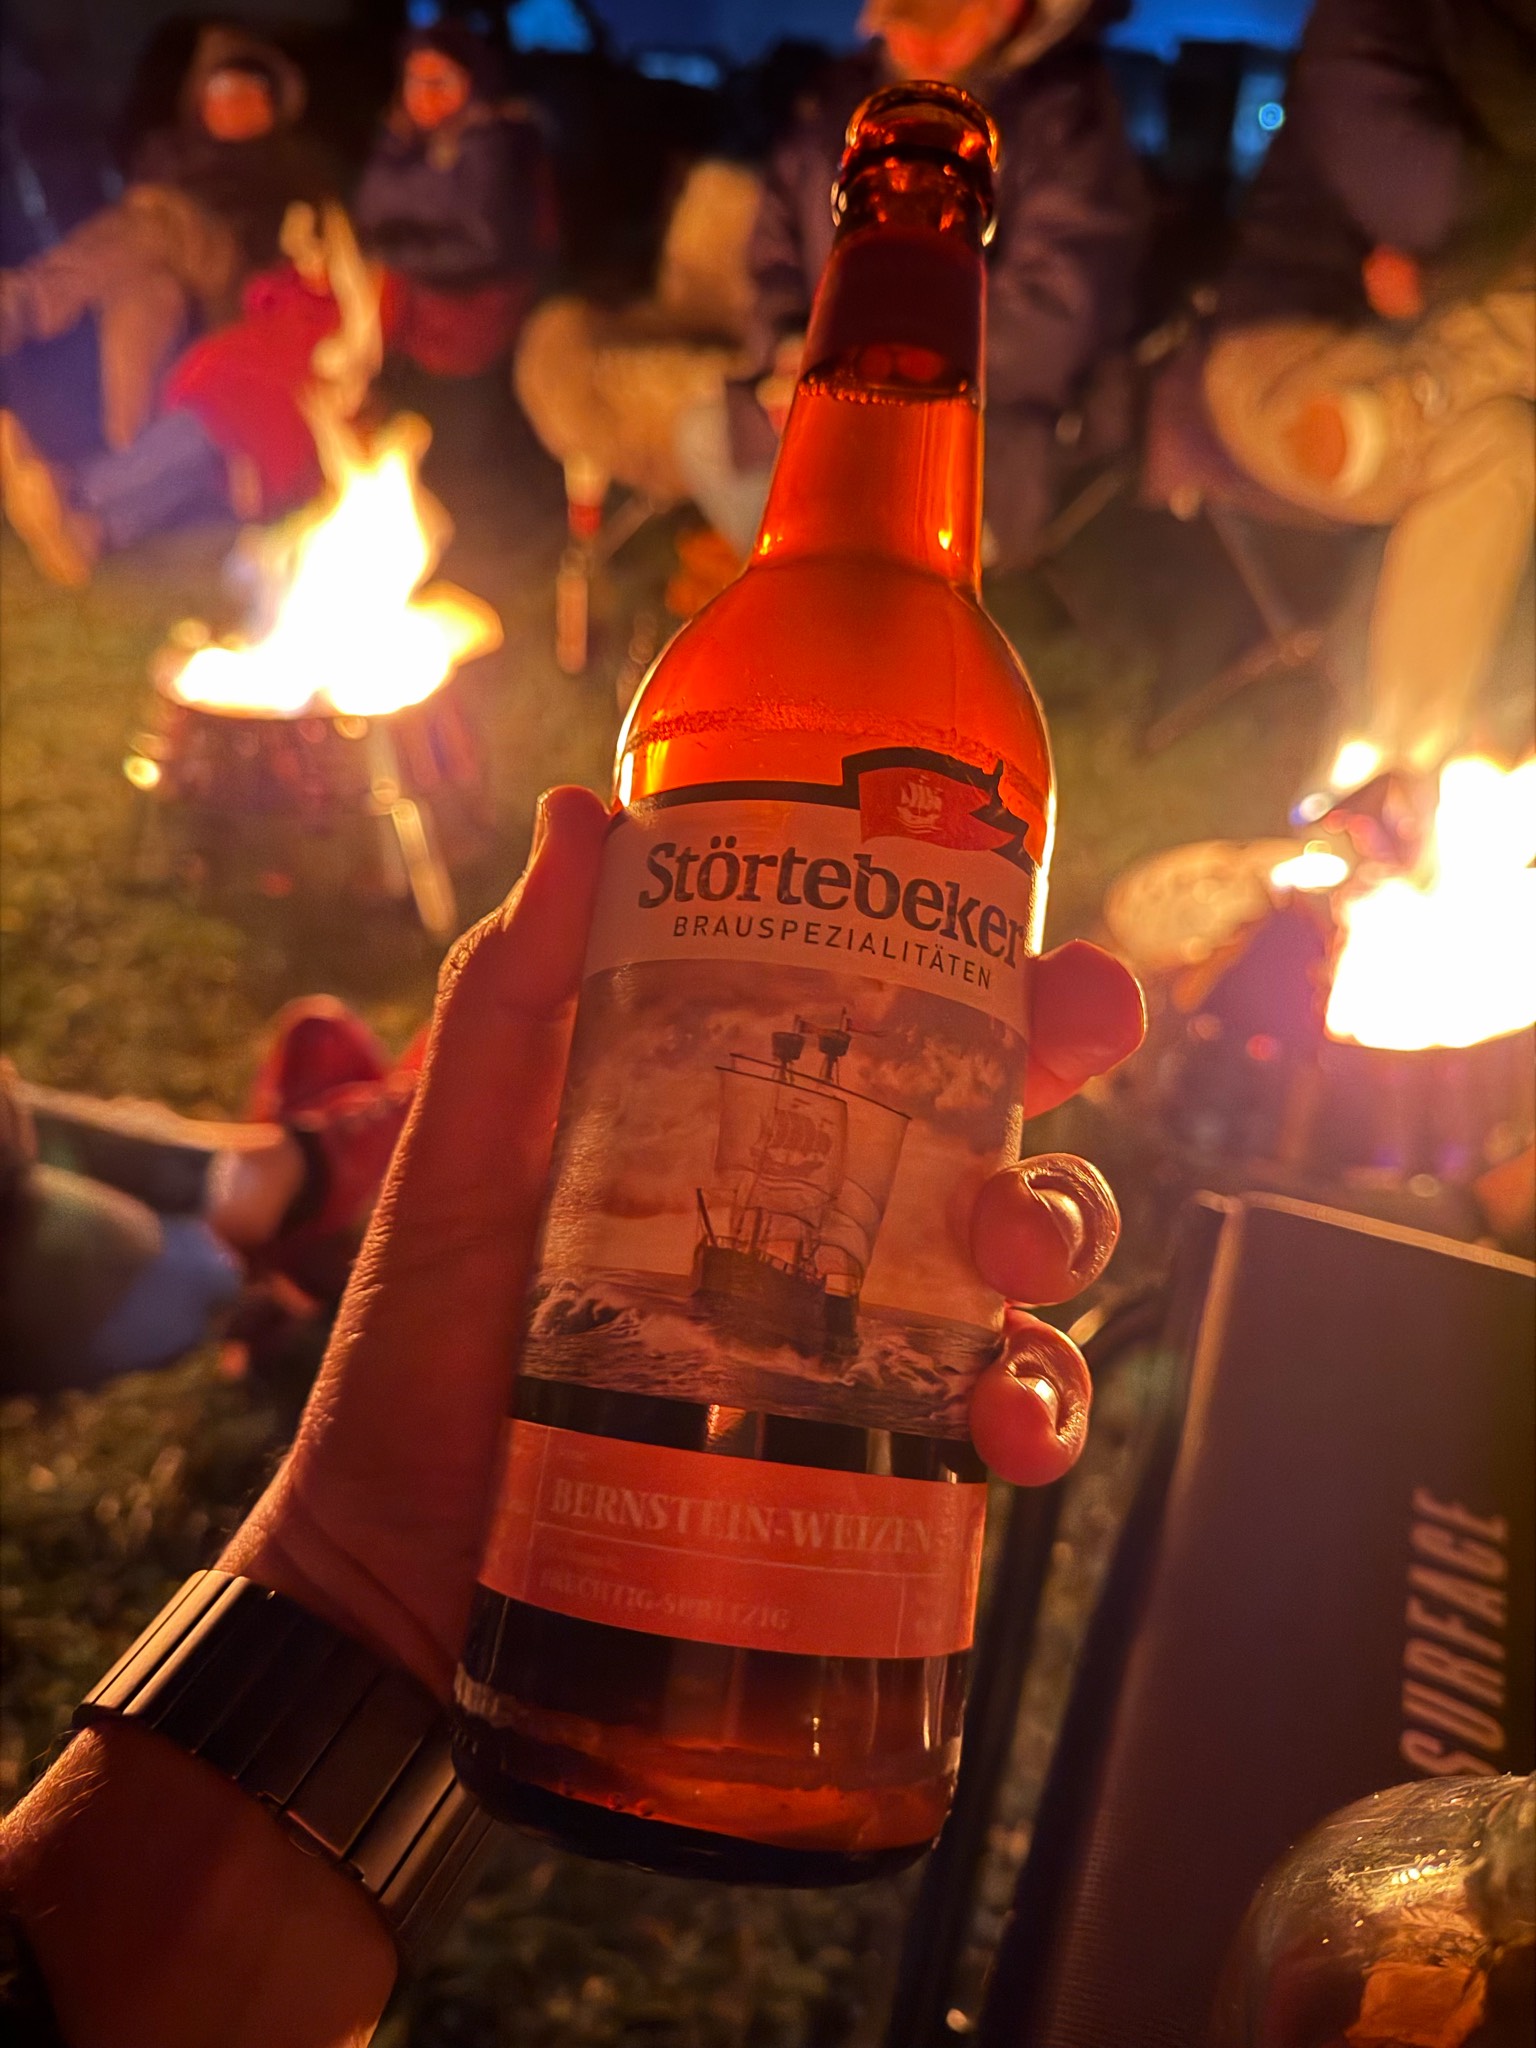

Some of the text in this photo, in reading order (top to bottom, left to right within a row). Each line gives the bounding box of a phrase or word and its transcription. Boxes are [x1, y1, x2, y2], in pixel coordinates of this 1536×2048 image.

[638, 835, 1025, 969] Störtebeker
[673, 915, 992, 990] BRAUSPEZIALITÄTEN
[550, 1476, 933, 1554] BERNSTEIN-WEIZEN
[1400, 1485, 1508, 1776] SURFACE
